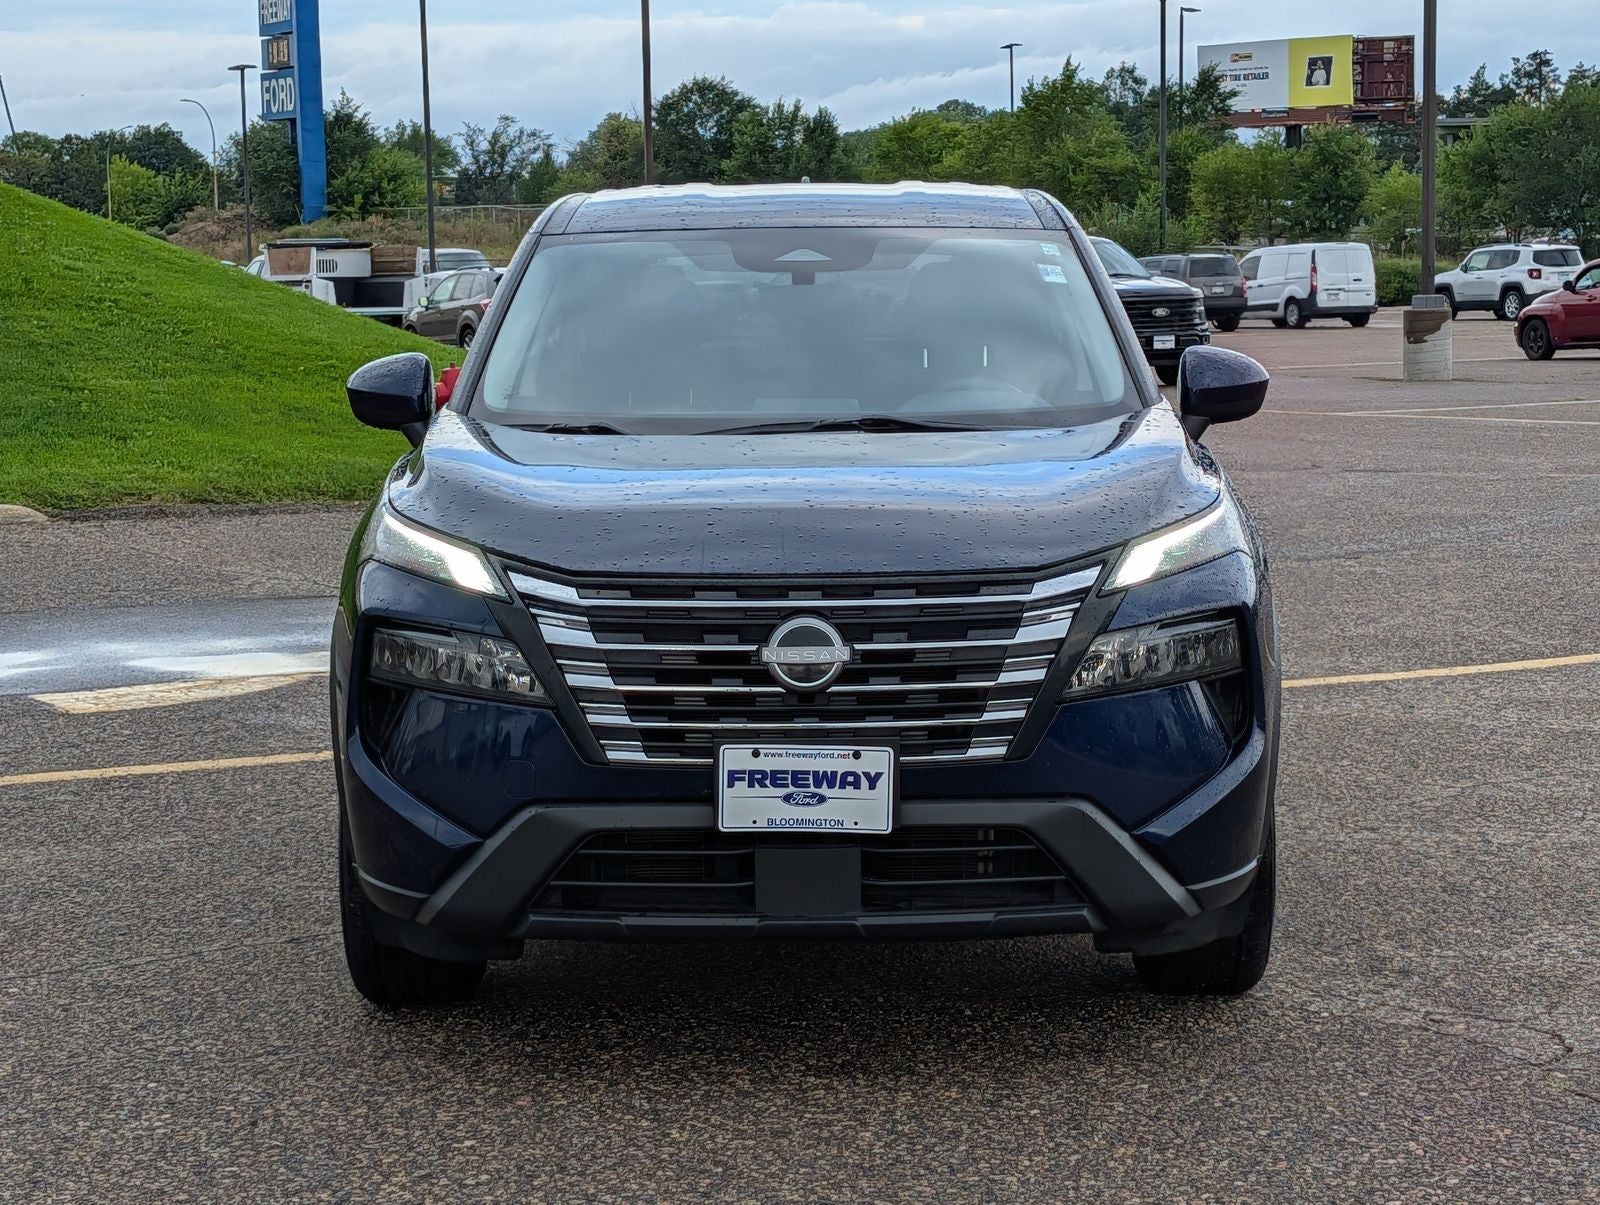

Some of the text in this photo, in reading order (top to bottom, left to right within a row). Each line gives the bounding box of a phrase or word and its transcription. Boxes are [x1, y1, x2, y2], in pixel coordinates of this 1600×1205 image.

[1243, 71, 1269, 81] RETAILER
[262, 77, 295, 113] FORD
[764, 649, 848, 661] NISSAN
[763, 751, 850, 760] www.freewayford.net
[726, 769, 885, 790] FREEWAY
[790, 792, 819, 805] Ford
[767, 818, 844, 827] BLOOMINGTON
